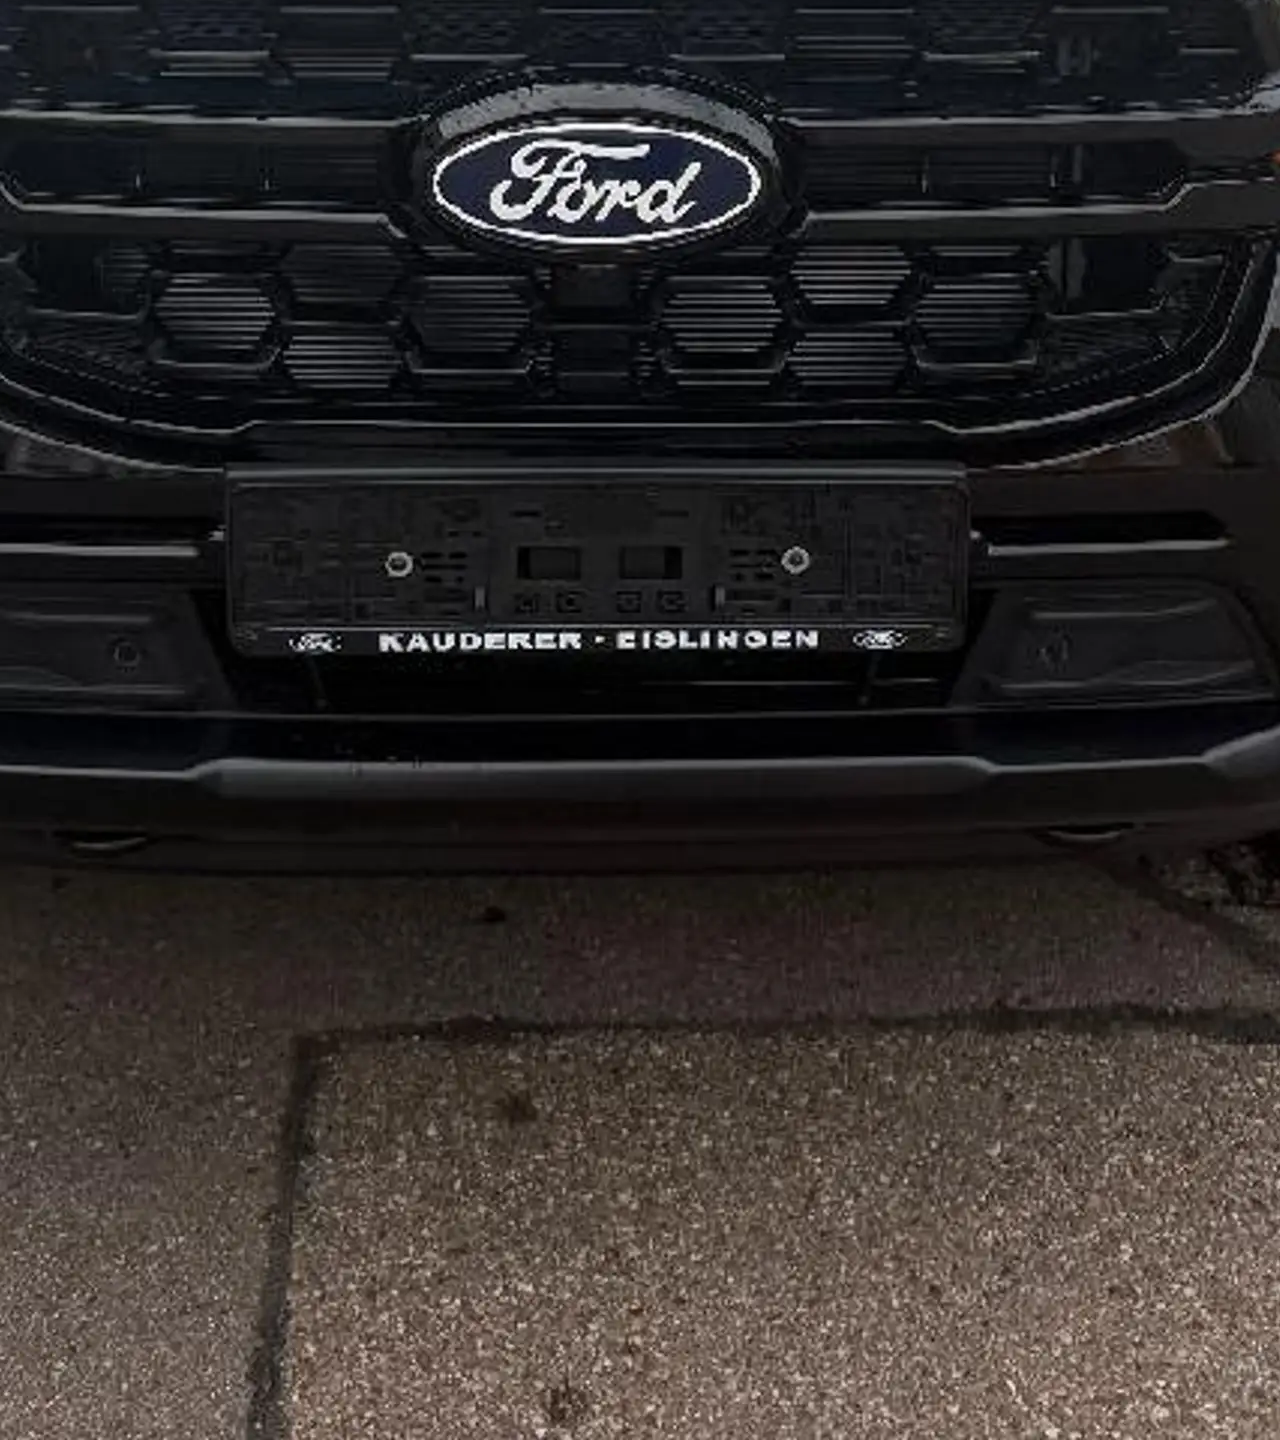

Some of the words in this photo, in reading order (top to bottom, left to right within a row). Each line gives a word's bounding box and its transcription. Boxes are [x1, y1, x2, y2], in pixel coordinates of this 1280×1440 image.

[489, 138, 702, 224] Ford
[378, 631, 582, 653] KAUDERER
[616, 629, 819, 650] EISLINGEN
